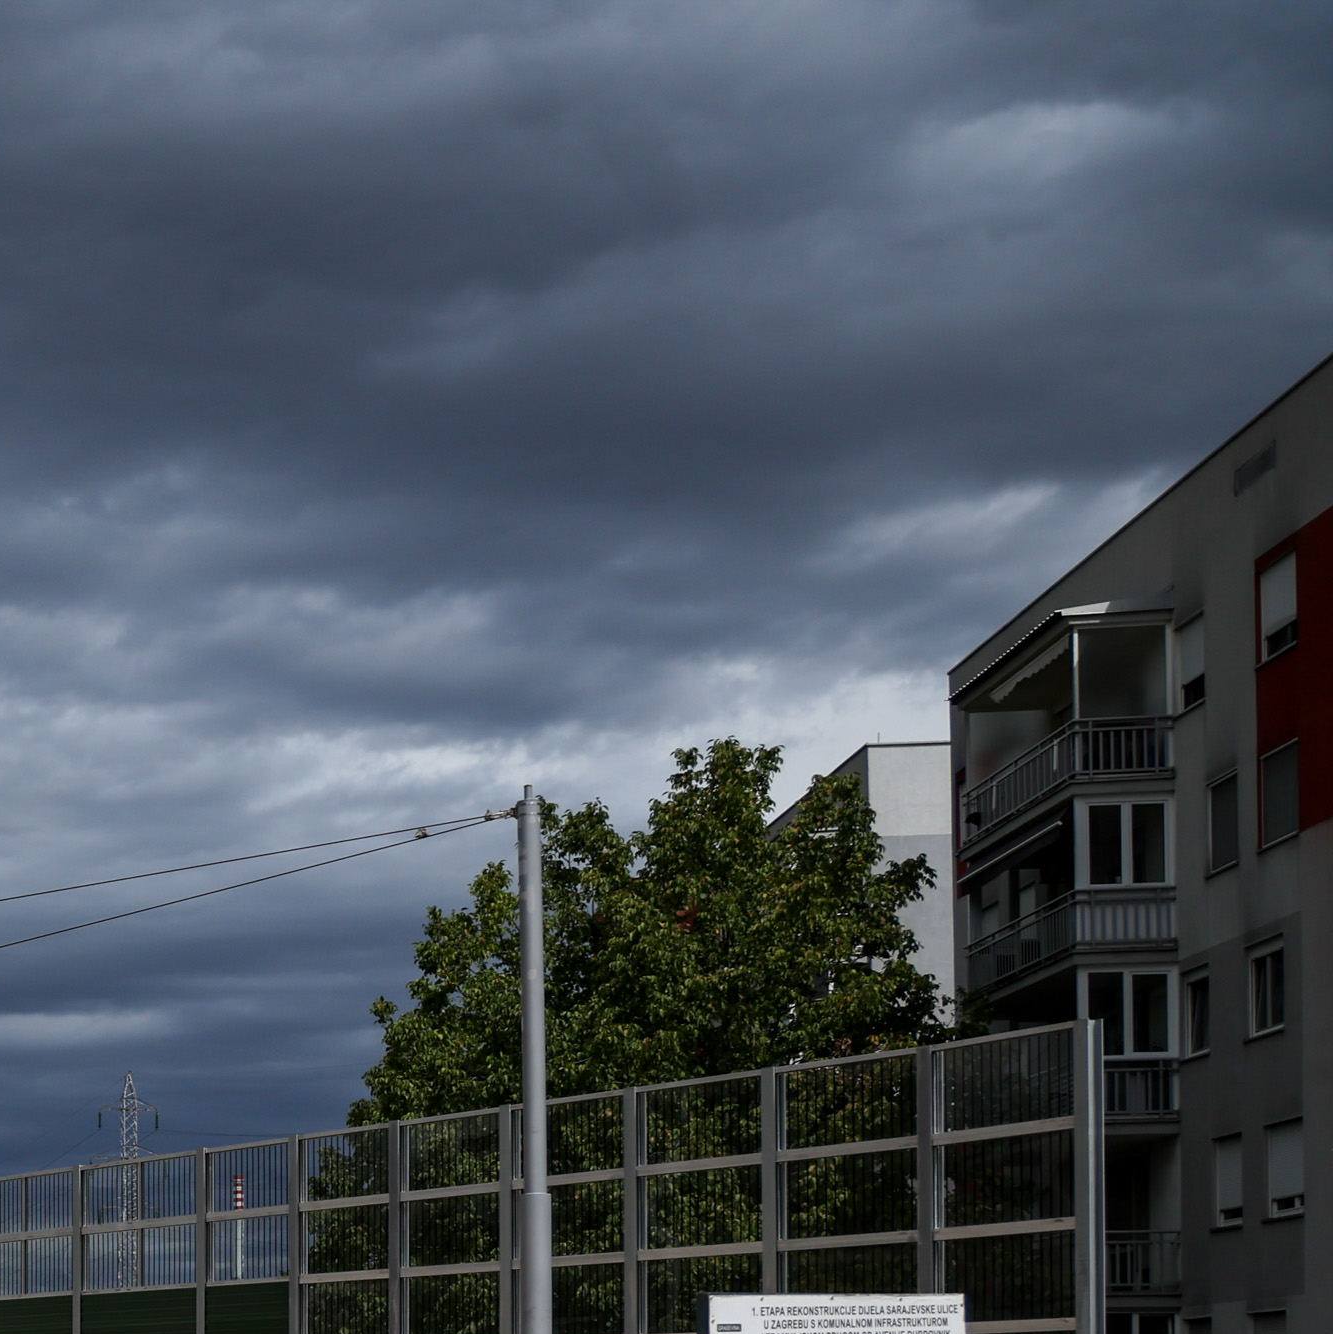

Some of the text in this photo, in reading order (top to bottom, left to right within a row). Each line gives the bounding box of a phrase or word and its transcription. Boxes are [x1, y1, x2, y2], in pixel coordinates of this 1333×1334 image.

[752, 1304, 958, 1317] 1. ETAPA REKONSTRUKCIJE DIJELA SARAJEVSKE ULICE
[764, 1317, 949, 1330] U ZAGREBU S KOMUNALNOM INFRASTRUKTUROM
